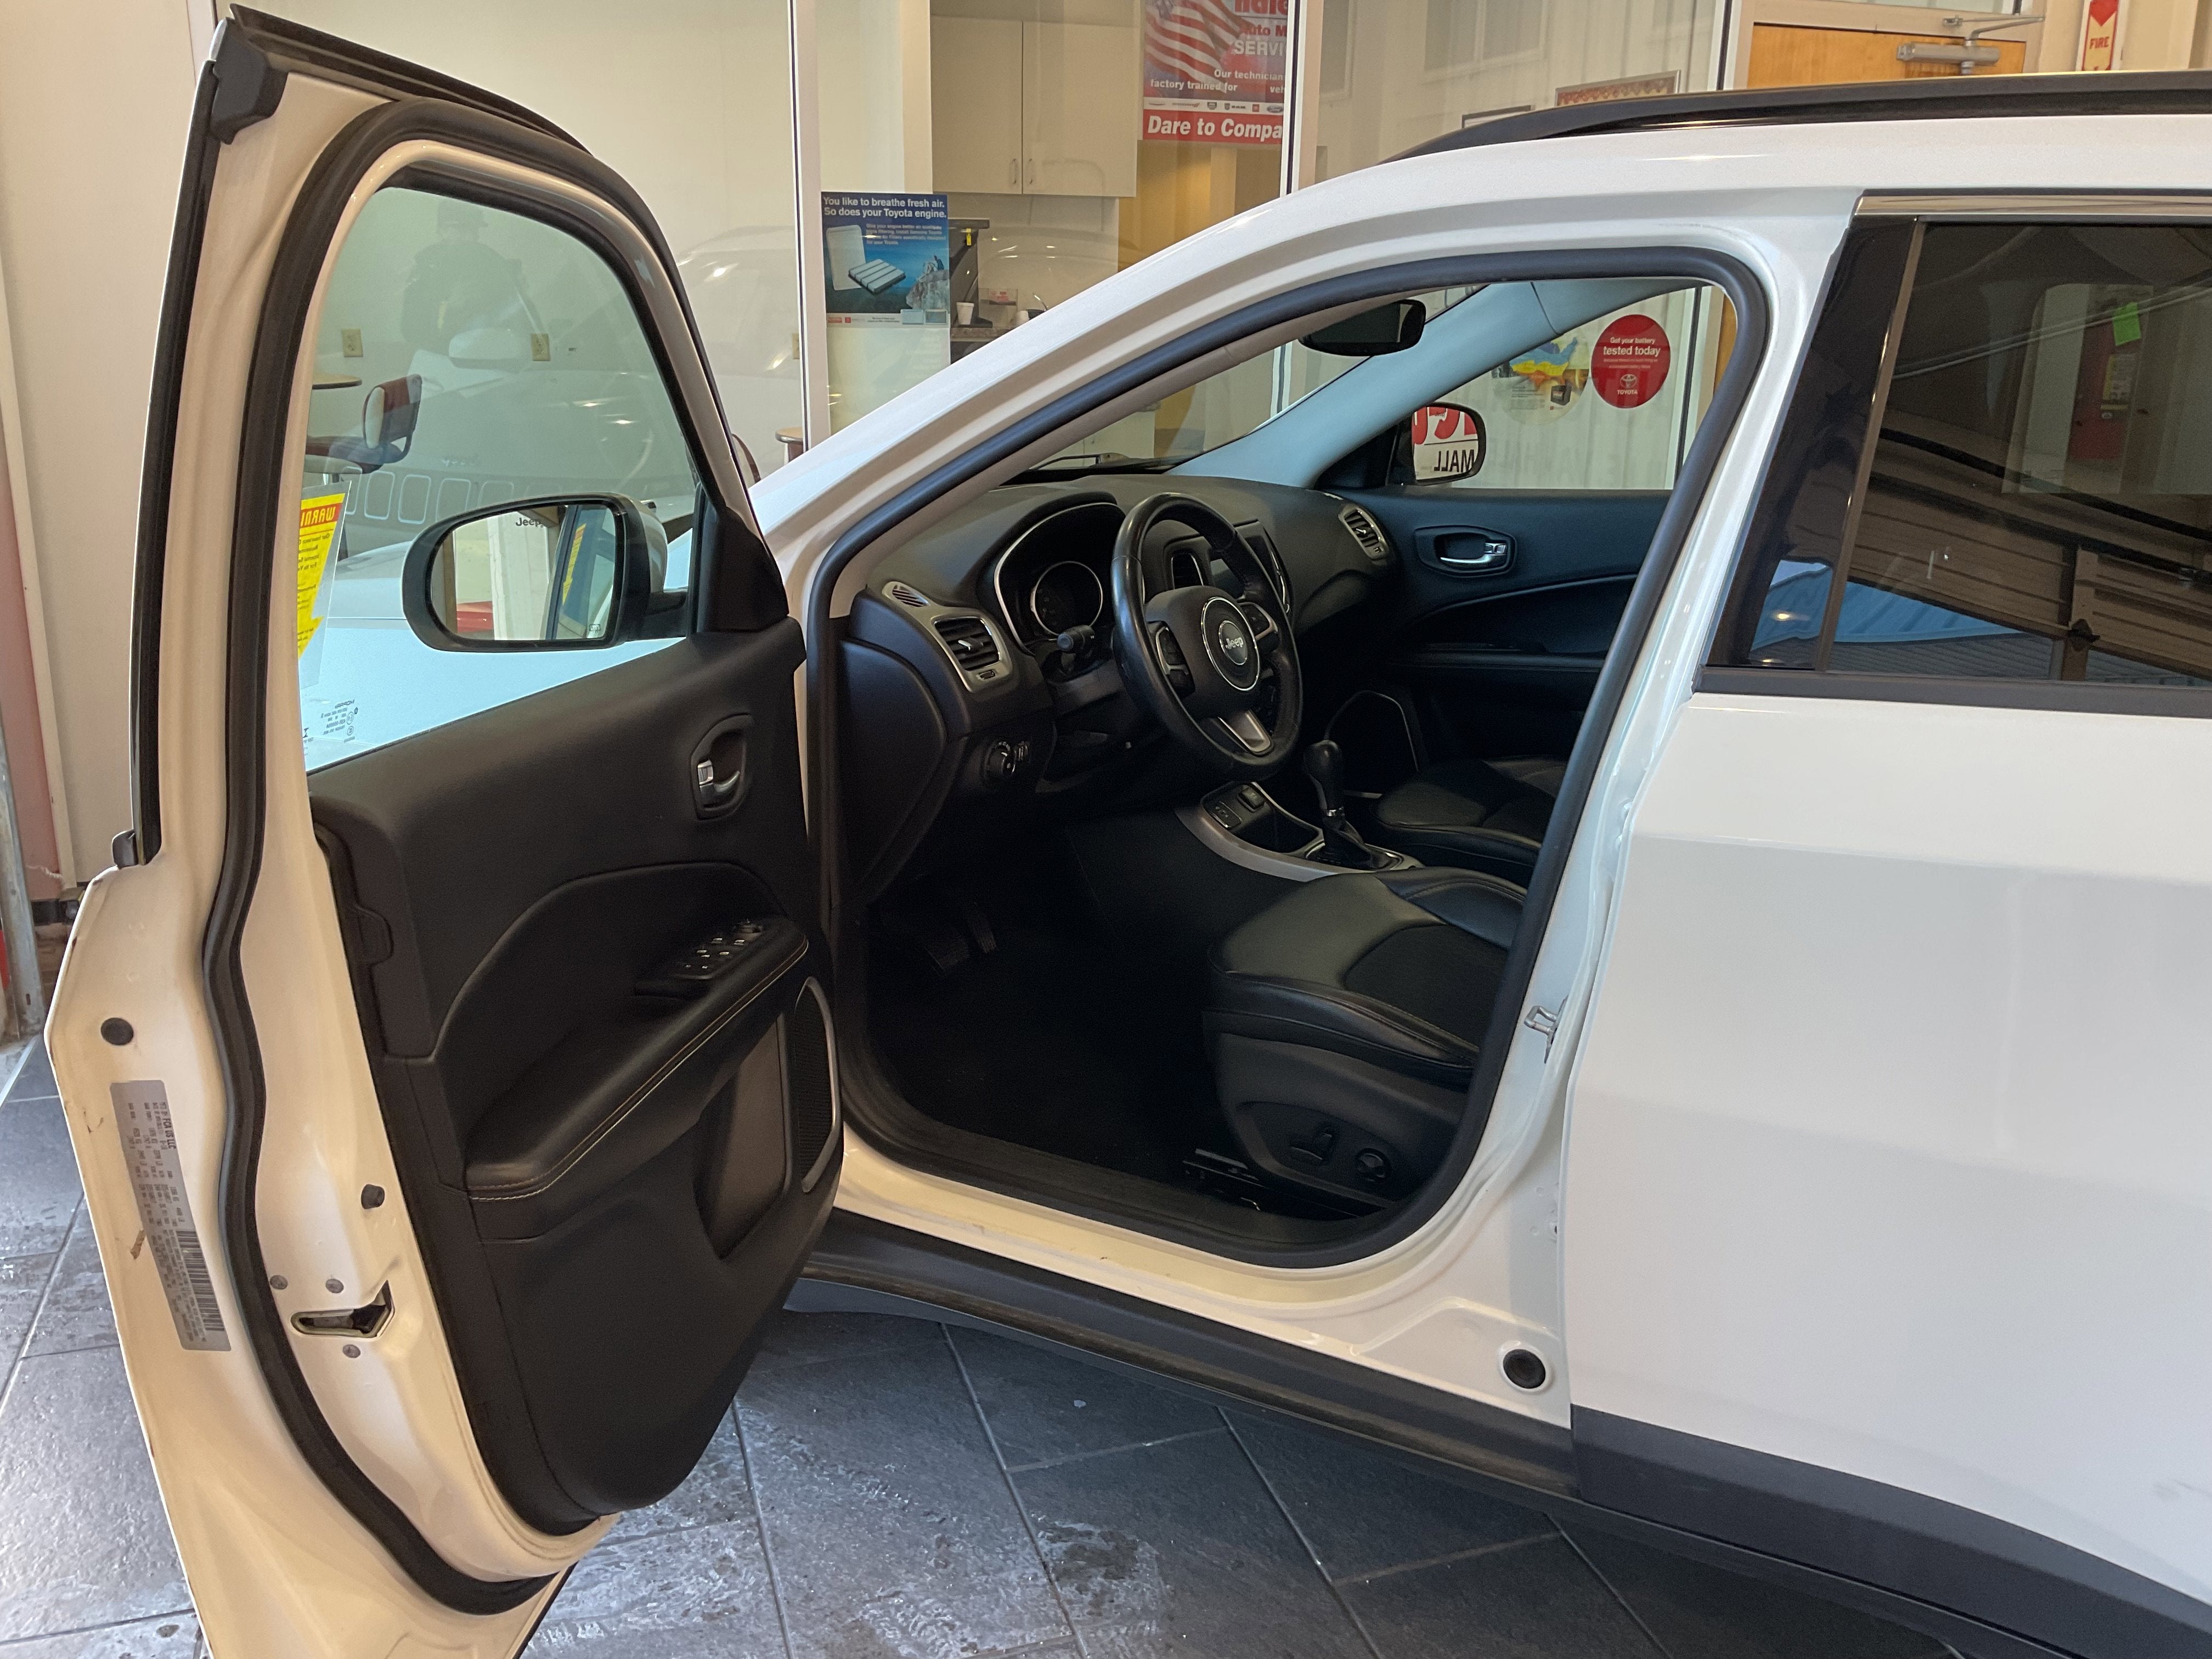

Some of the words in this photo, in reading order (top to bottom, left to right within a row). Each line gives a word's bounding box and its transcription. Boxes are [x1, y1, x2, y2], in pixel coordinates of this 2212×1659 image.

[1234, 40, 1286, 55] SERVI
[2089, 36, 2109, 49] FIRE
[1214, 69, 1232, 78] Our
[1234, 70, 1284, 80] technician
[1150, 78, 1184, 91] factory
[1187, 81, 1221, 91] trained
[1224, 82, 1238, 92] for
[1148, 115, 1190, 134] Dare
[1198, 118, 1215, 136] to
[823, 197, 840, 206] You
[842, 198, 858, 206] like
[871, 198, 905, 207] breathe
[907, 199, 929, 207] fresh
[824, 207, 837, 216] So
[838, 207, 860, 216] does
[862, 209, 883, 218] your
[884, 208, 912, 218] Toyota
[915, 210, 947, 219] engine.
[1603, 346, 1633, 356] tested
[1635, 346, 1661, 357] today
[516, 517, 540, 527] Jeep
[1225, 637, 1244, 650] Jeep
[162, 1118, 171, 1128] FCA
[167, 1139, 176, 1149] LLC
